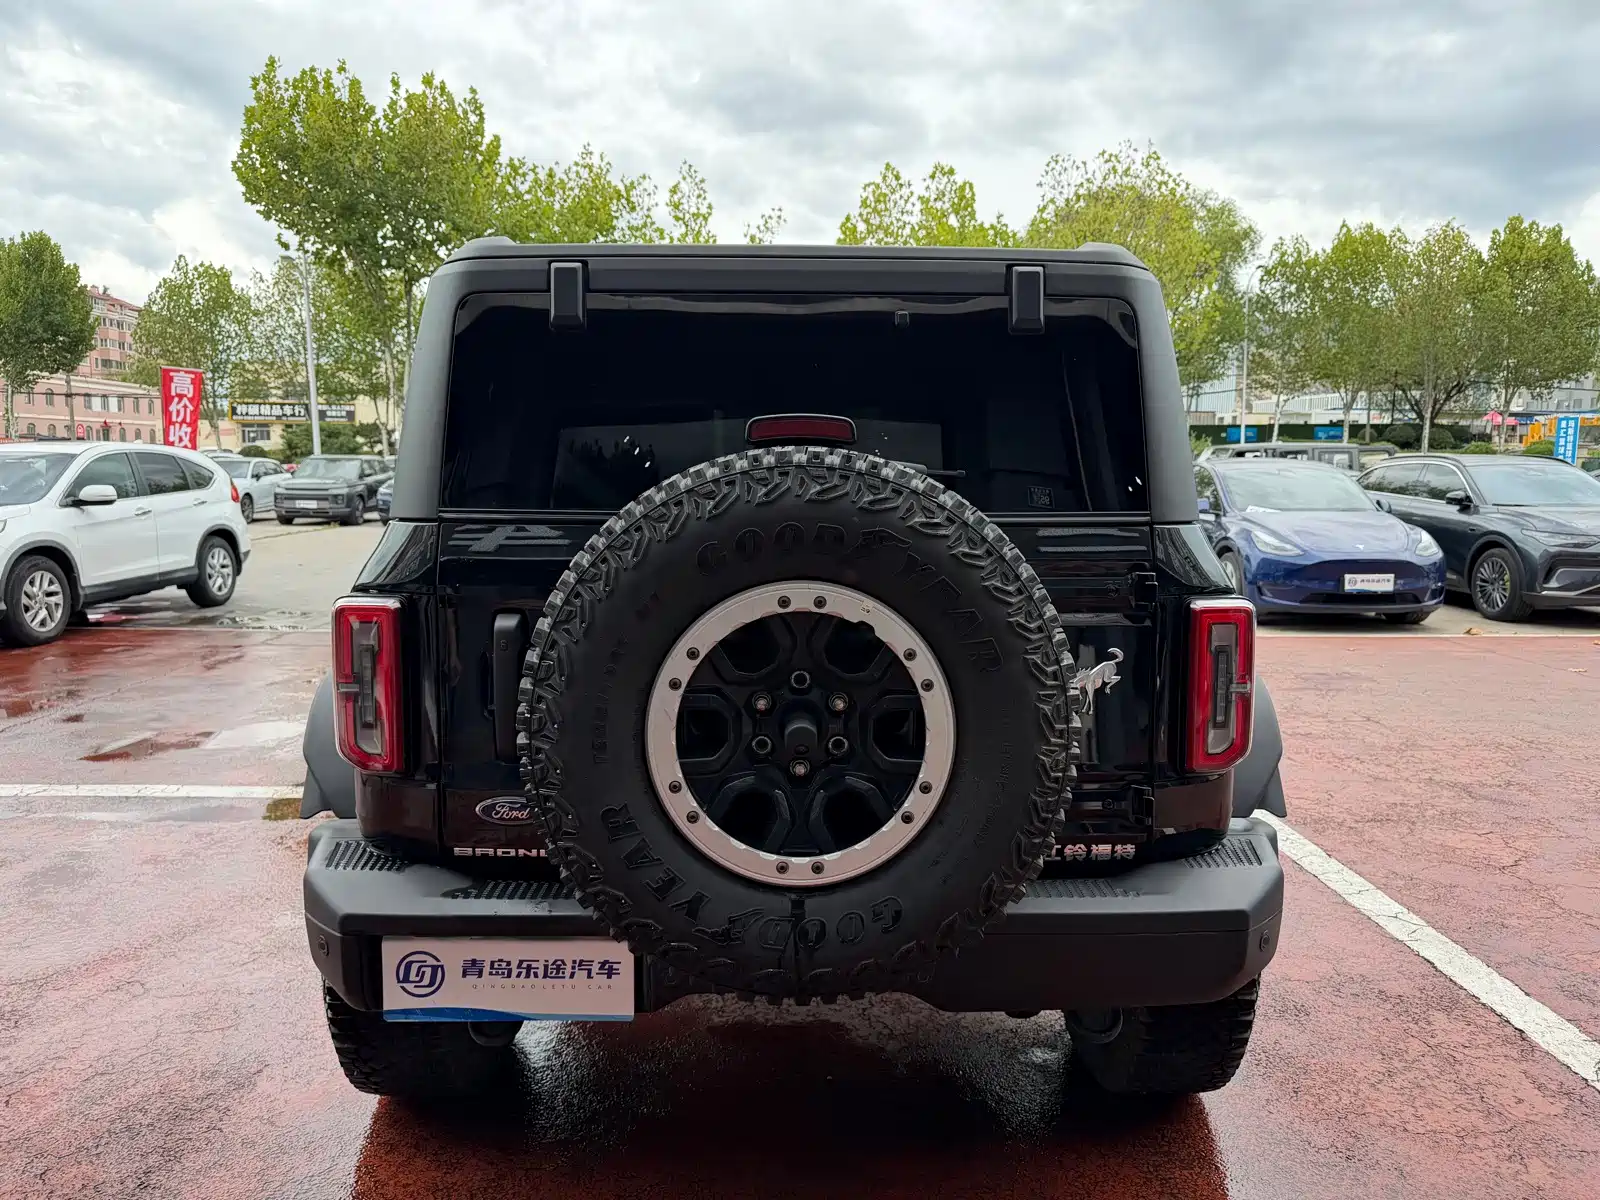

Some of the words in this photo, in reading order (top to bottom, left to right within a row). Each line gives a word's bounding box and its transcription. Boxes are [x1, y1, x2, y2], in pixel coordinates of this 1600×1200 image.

[169, 371, 195, 449] 高价收
[695, 521, 1005, 674] GOODYEAR
[491, 802, 530, 820] Ford
[599, 800, 905, 950] GOODYEAR
[461, 958, 621, 980] 青岛乐途汽车
